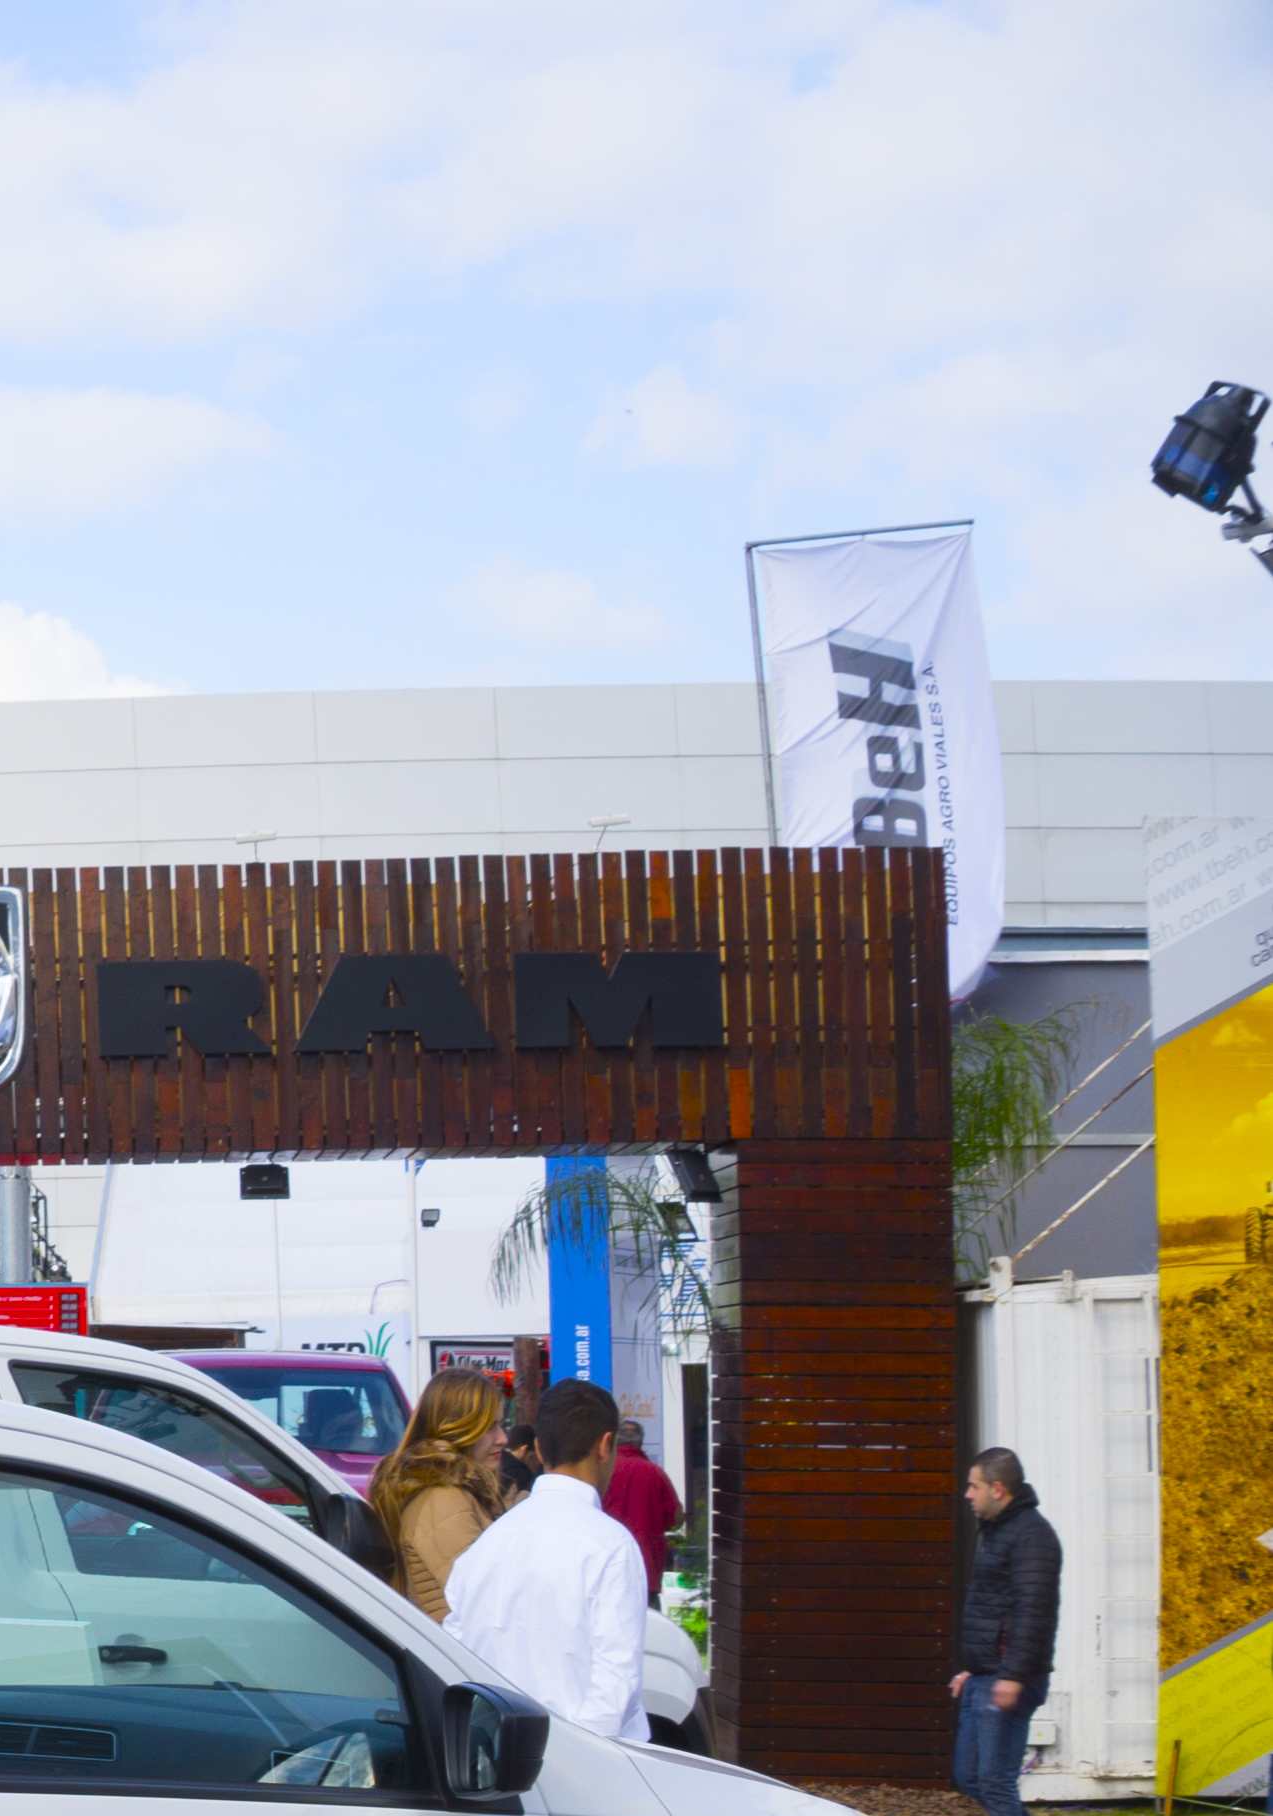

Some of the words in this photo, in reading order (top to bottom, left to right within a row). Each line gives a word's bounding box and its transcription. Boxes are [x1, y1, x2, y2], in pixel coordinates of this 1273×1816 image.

[922, 661, 939, 696] S.A.
[928, 702, 948, 770] VIALES
[937, 775, 954, 832] AGRO
[97, 952, 723, 1057] RAM
